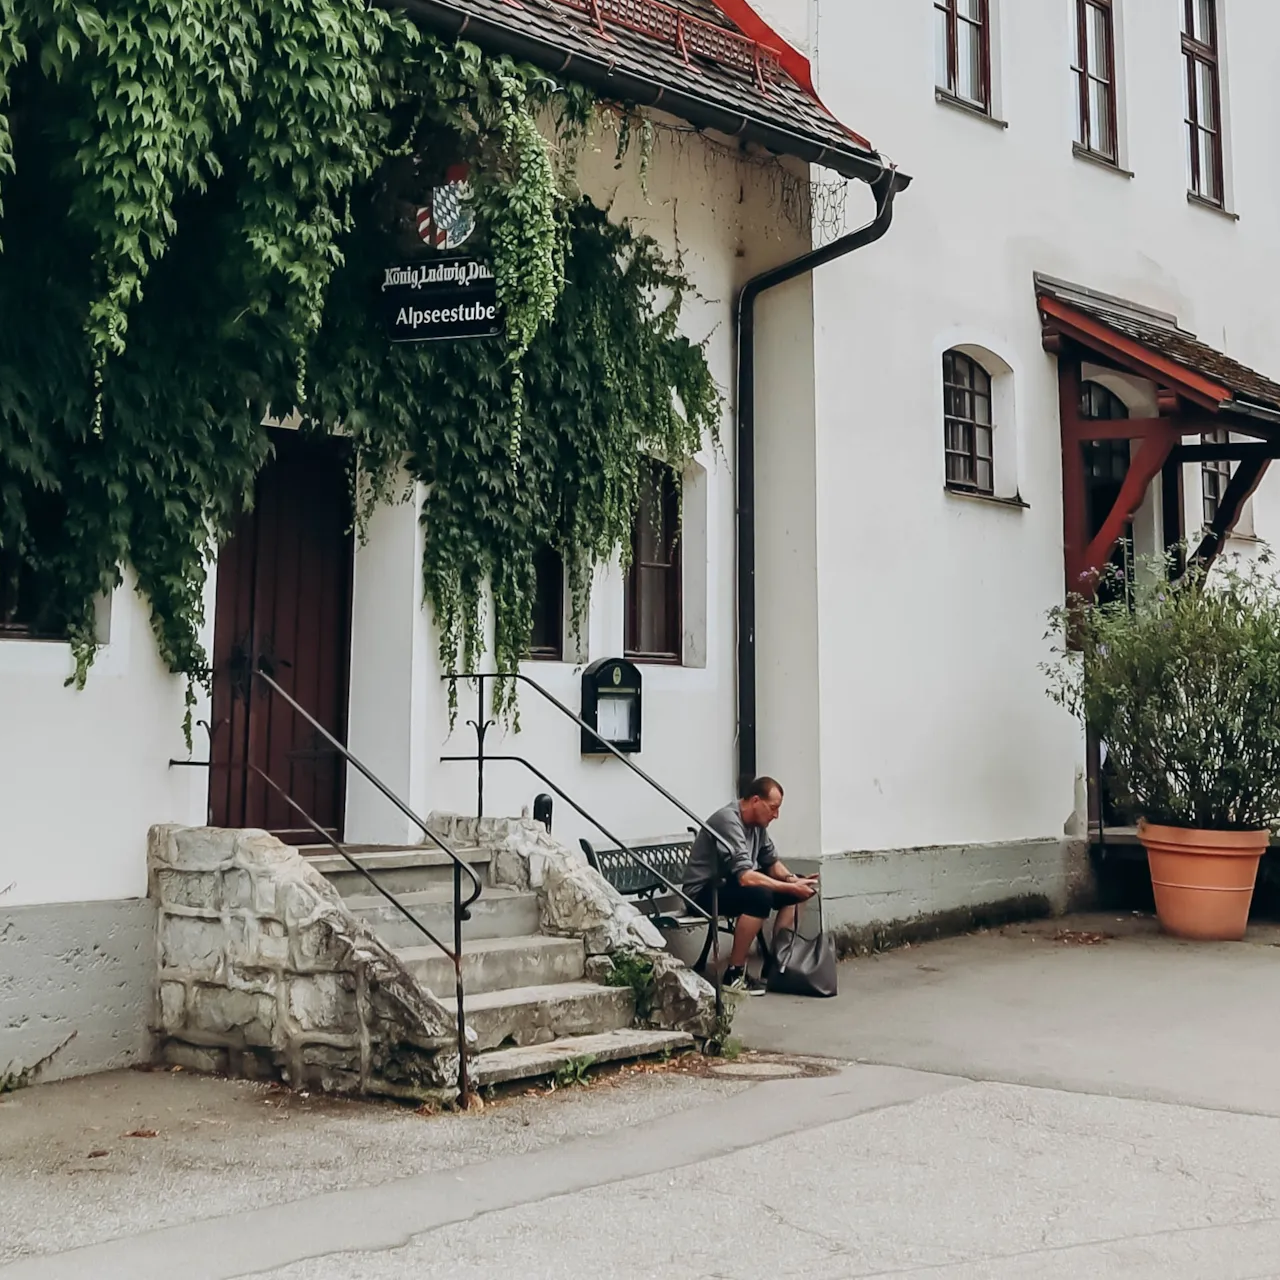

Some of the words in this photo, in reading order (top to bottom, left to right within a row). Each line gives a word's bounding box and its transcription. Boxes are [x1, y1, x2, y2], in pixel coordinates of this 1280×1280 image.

[381, 266, 419, 292] König
[418, 262, 466, 289] Ludwig
[395, 301, 496, 329] Alpseestube
